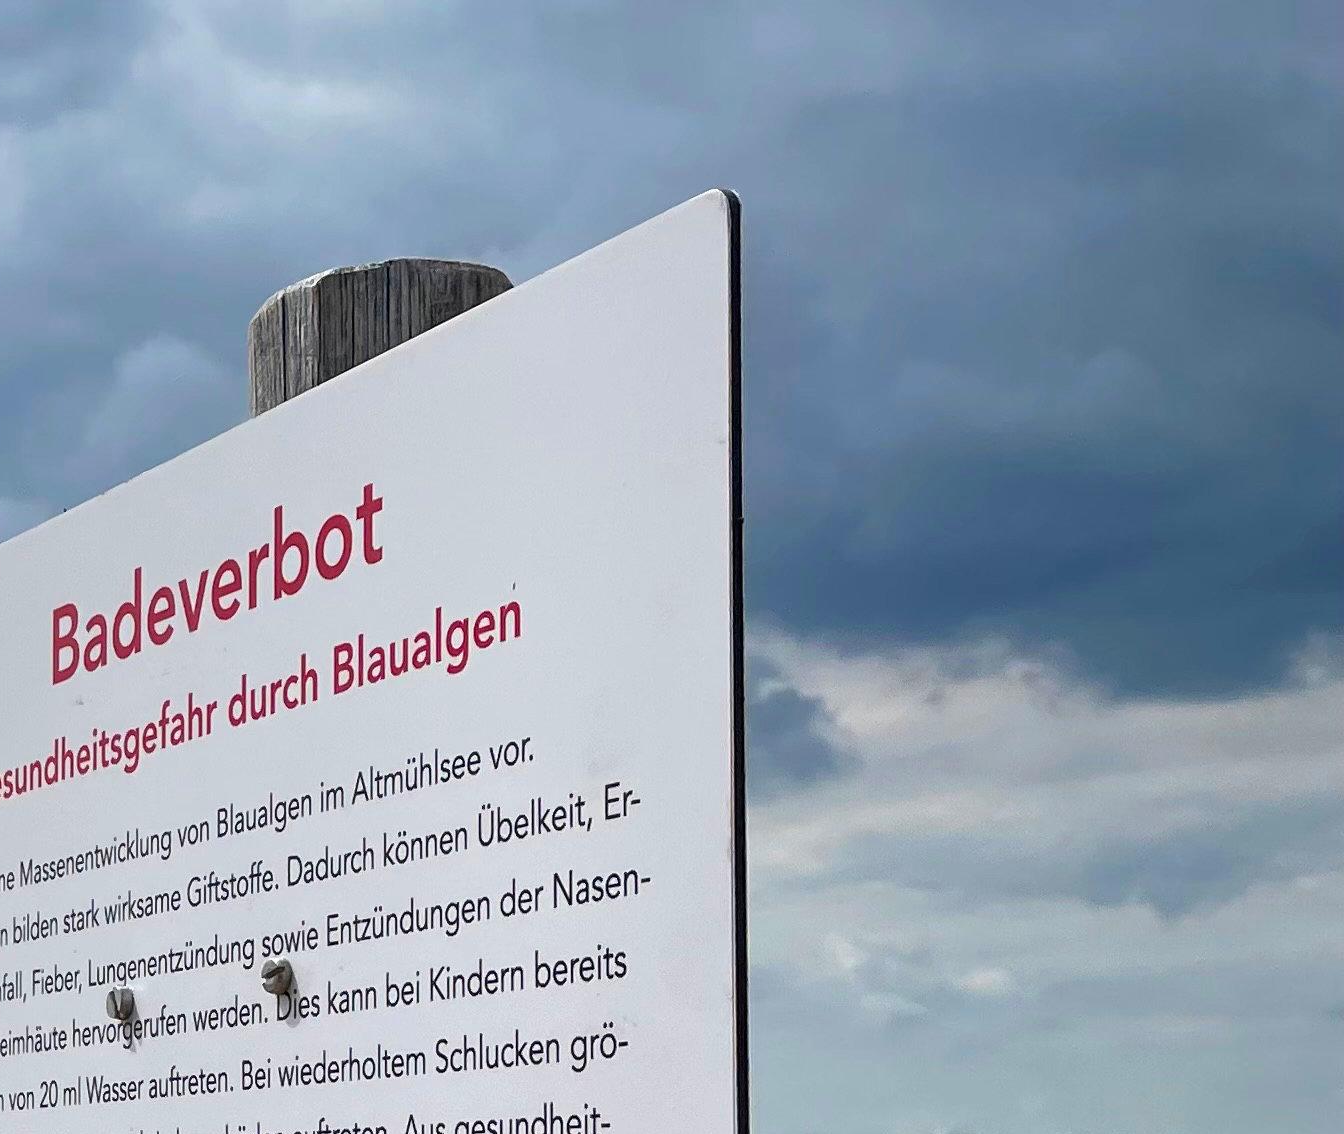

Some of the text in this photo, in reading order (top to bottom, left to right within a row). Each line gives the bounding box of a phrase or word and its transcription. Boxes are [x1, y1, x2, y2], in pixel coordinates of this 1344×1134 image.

[52, 483, 383, 686] Badeverbot
[228, 653, 318, 727] durch
[333, 601, 520, 695] Blaualgen
[12, 911, 58, 944] bilden
[63, 899, 99, 934] stark
[104, 890, 181, 924] wirksame
[187, 860, 279, 907] Giftstoffe.
[287, 837, 374, 886] Dadurch
[383, 827, 467, 867] können
[478, 793, 592, 847] Übelkeit,
[605, 782, 641, 820] Er-
[20, 828, 172, 887] Massenentwicklung
[177, 820, 209, 847] von
[217, 792, 312, 838] Blaualgen
[320, 782, 344, 813] im
[351, 748, 481, 805] Altmühlsee
[489, 737, 533, 769] vor.
[32, 964, 82, 996] Fieber,
[88, 934, 254, 987] Lungenentzündung
[261, 921, 318, 958] sowie
[327, 896, 490, 946] Entzündungen
[500, 878, 544, 917] der
[553, 869, 650, 909] Nasen-
[72, 1001, 186, 1049] hervorgerufen
[192, 994, 269, 1032] werden.
[275, 988, 321, 1022] Dies
[327, 980, 378, 1015] kann
[386, 970, 420, 1007] bei
[430, 958, 524, 1002] Kindern
[535, 944, 627, 988] bereits
[8, 1091, 34, 1111] von
[39, 1080, 58, 1108] 20
[63, 1076, 81, 1106] ml
[85, 1075, 144, 1104] Wasser
[148, 1065, 233, 1099] auftreten.
[241, 1058, 271, 1090] Bei
[277, 1044, 426, 1087] wiederholtem
[435, 1029, 560, 1073] Schlucken
[571, 1021, 628, 1073] grö-
